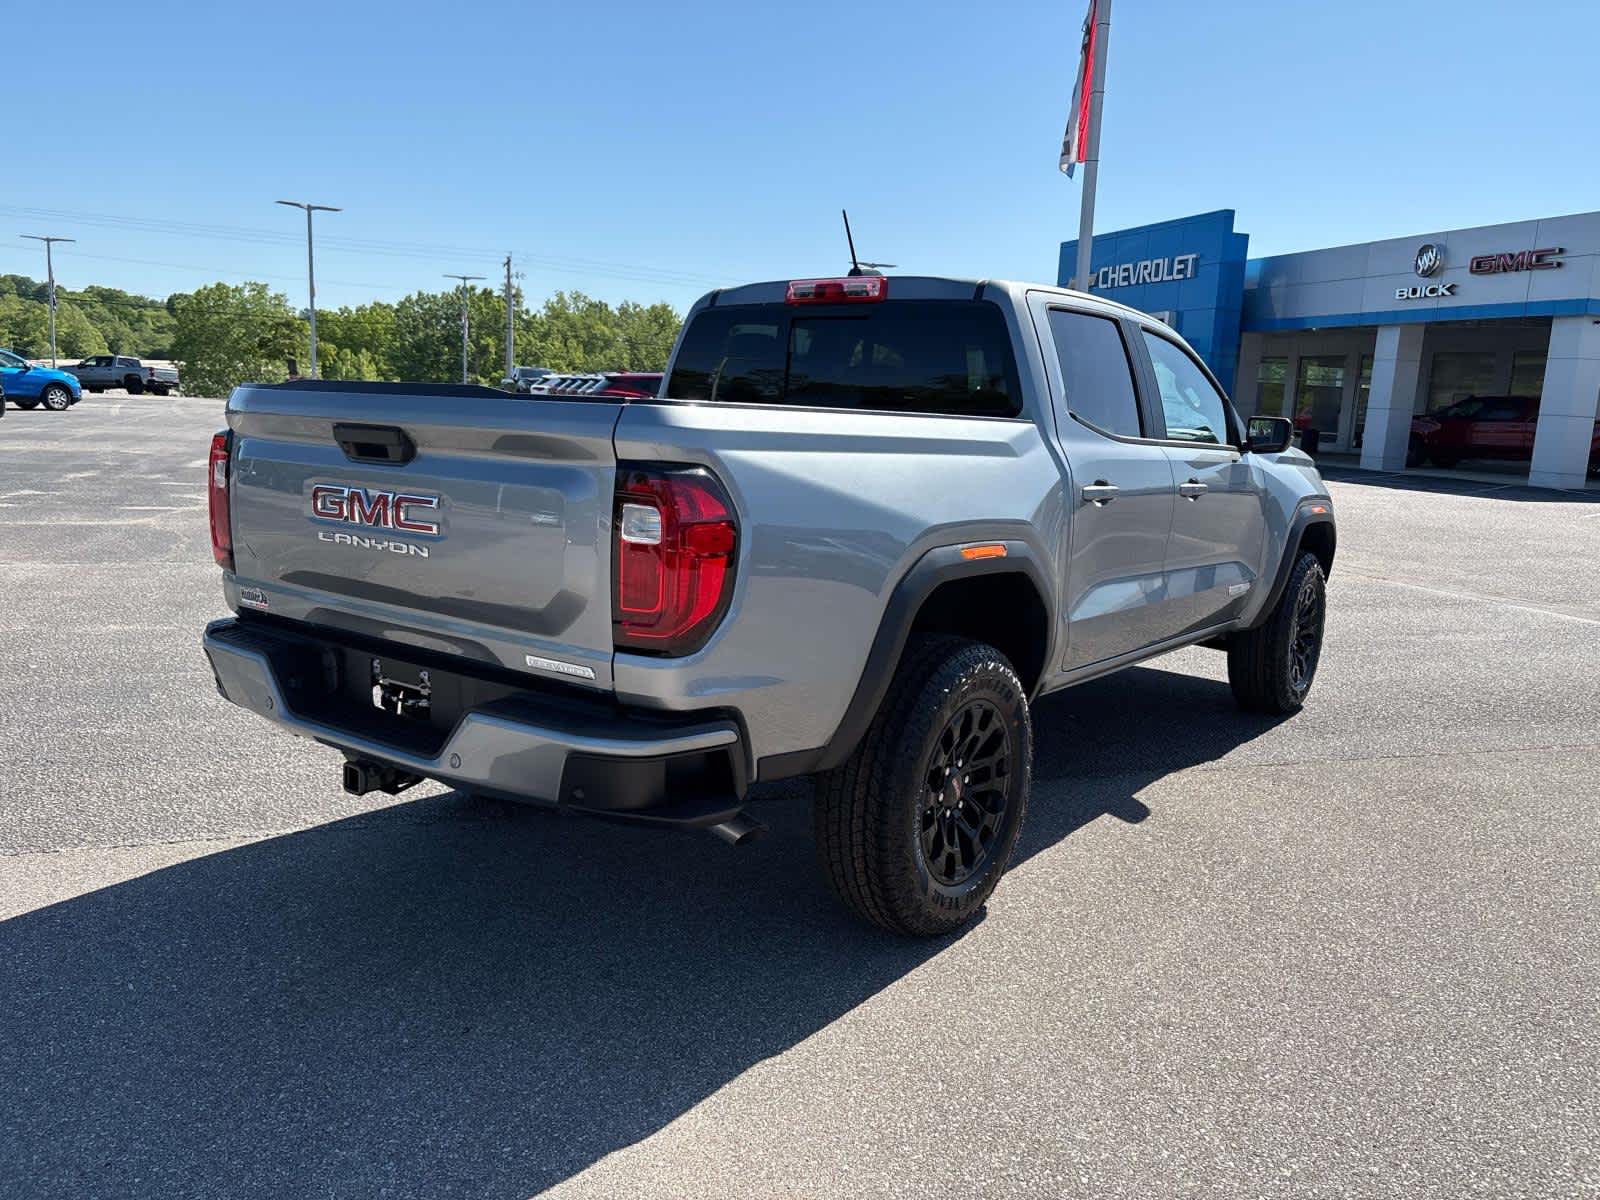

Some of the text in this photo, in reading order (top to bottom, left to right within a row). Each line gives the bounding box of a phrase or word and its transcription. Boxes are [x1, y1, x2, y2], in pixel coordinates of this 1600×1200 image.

[1098, 254, 1198, 289] CHEVROLET
[1469, 248, 1563, 275] GMC
[1395, 284, 1453, 300] BUICK
[312, 484, 439, 535] GMC
[318, 531, 429, 558] CANYON
